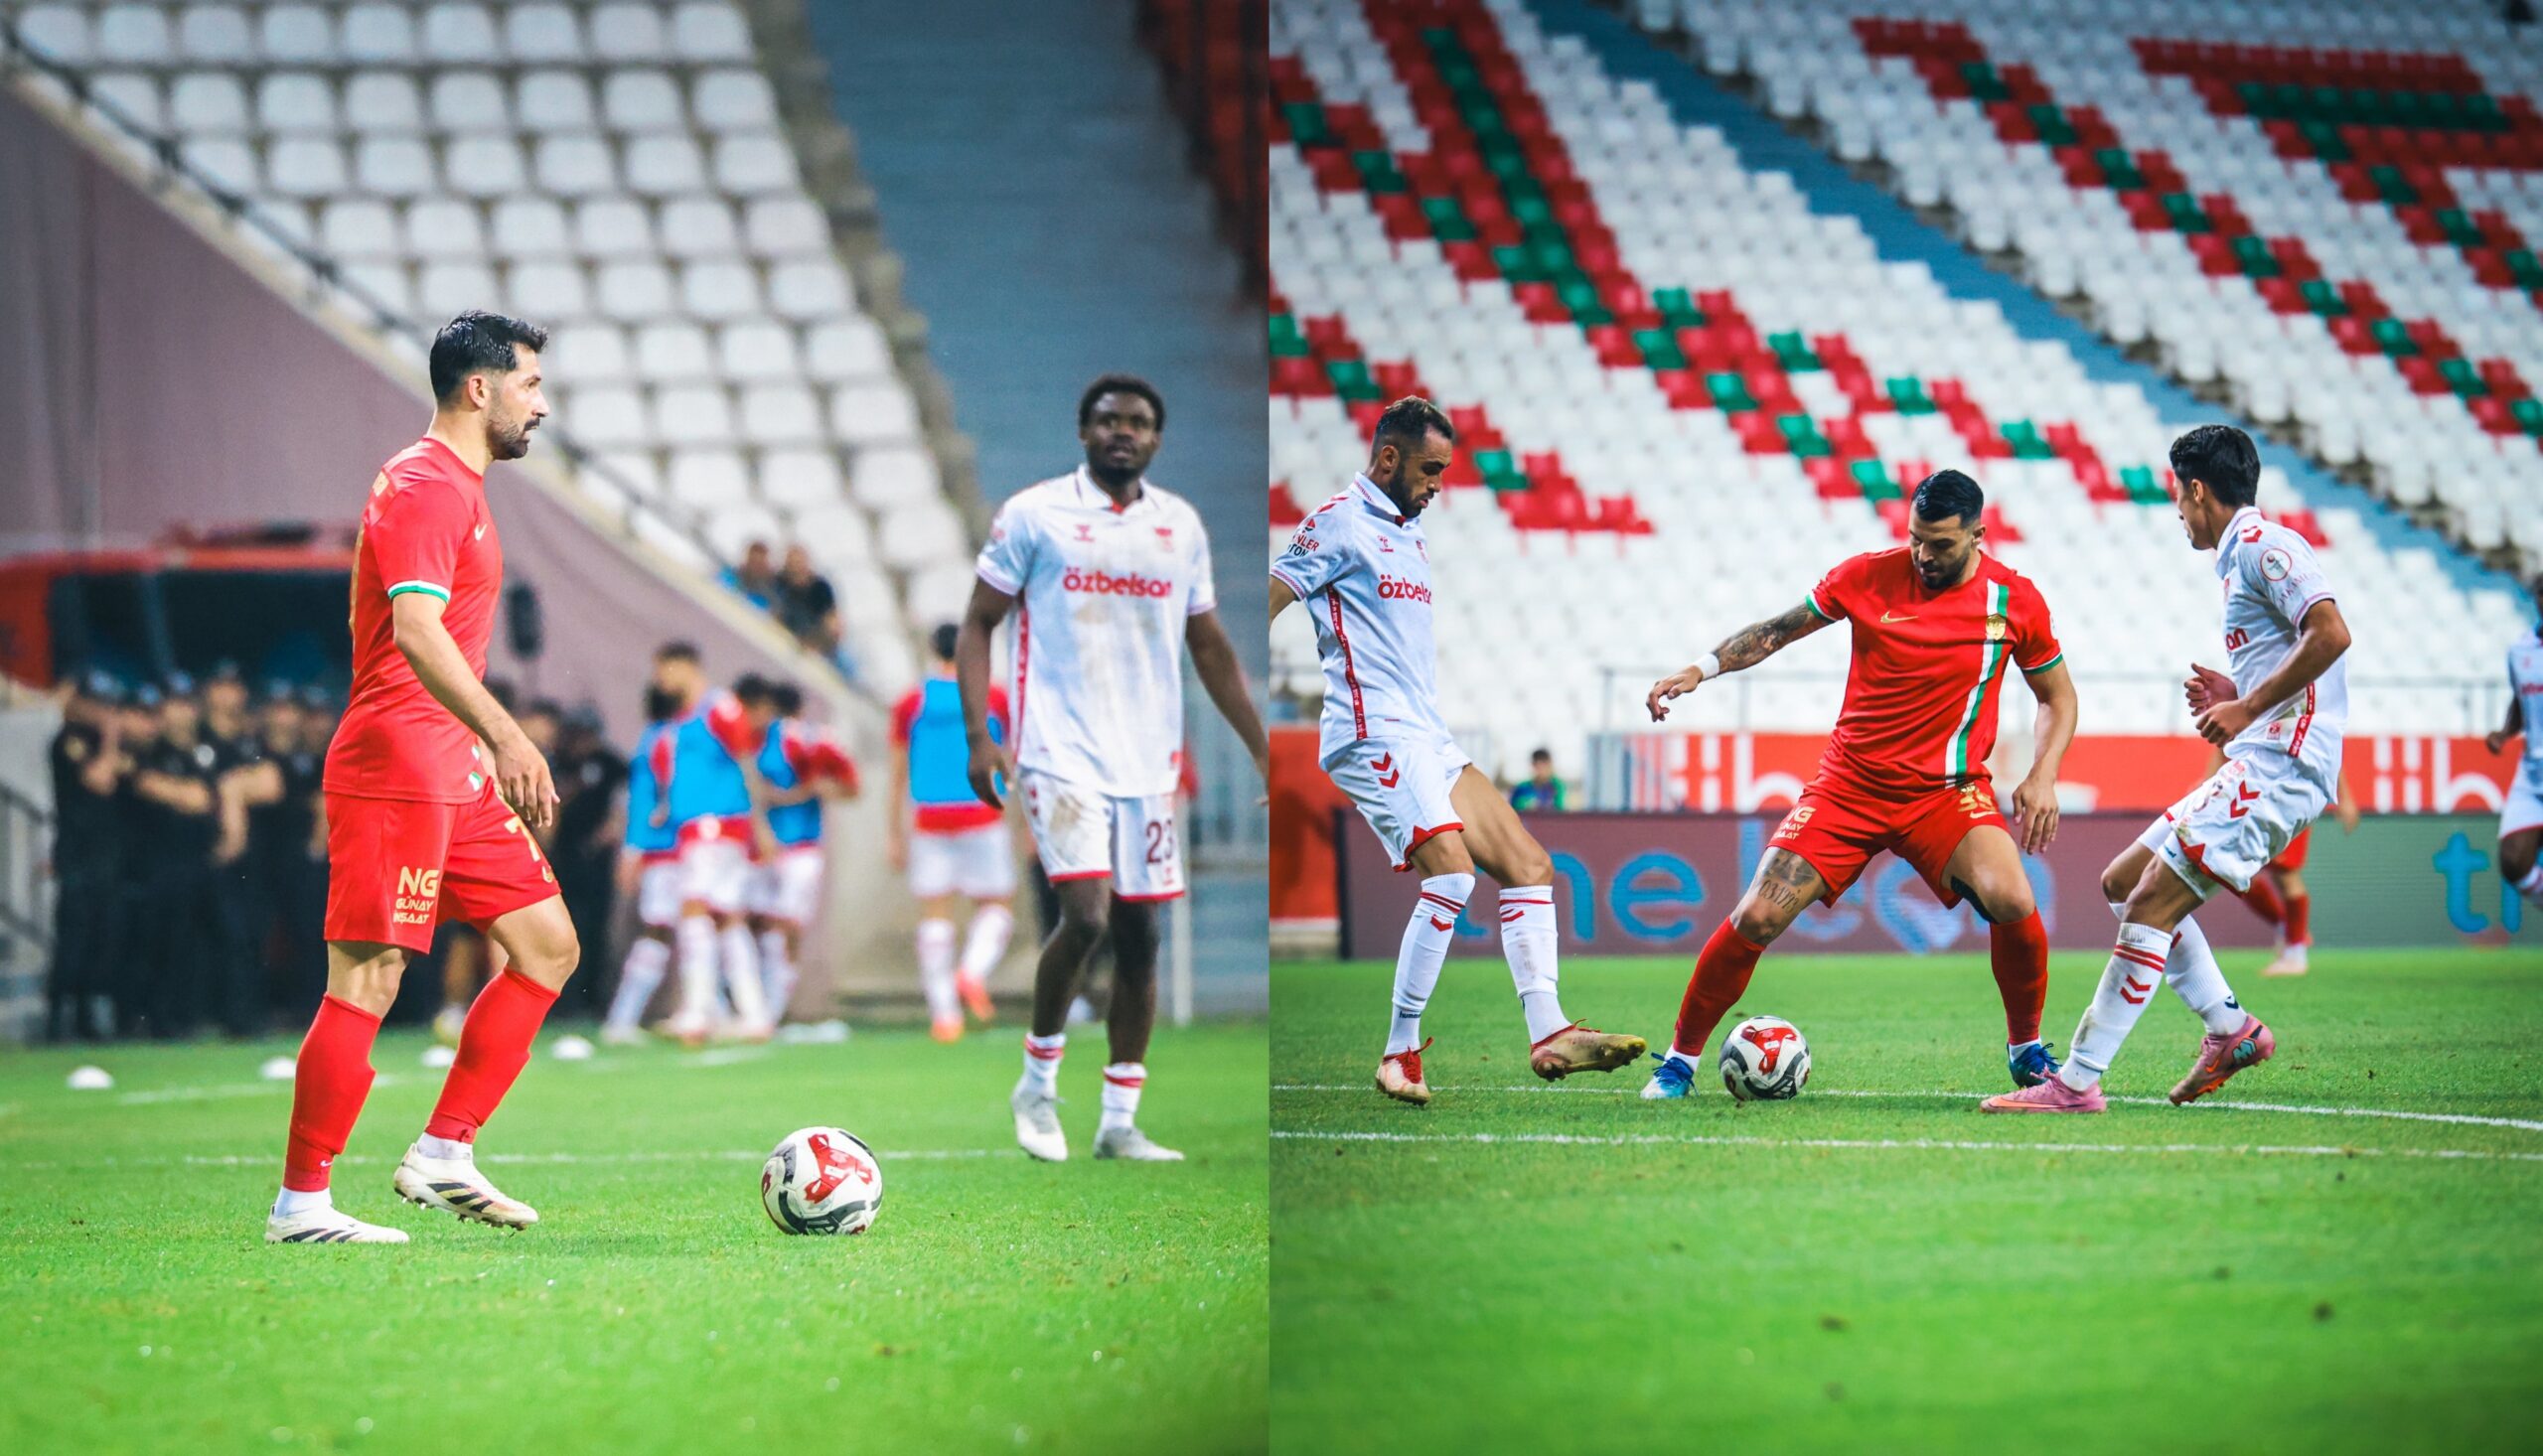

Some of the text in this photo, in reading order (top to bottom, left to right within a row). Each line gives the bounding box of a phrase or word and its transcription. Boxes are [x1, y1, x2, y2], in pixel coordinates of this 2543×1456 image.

[504, 815, 540, 862] 7
[1146, 819, 1173, 863] 23
[397, 865, 439, 898] NG
[395, 896, 434, 912] GÜNAY
